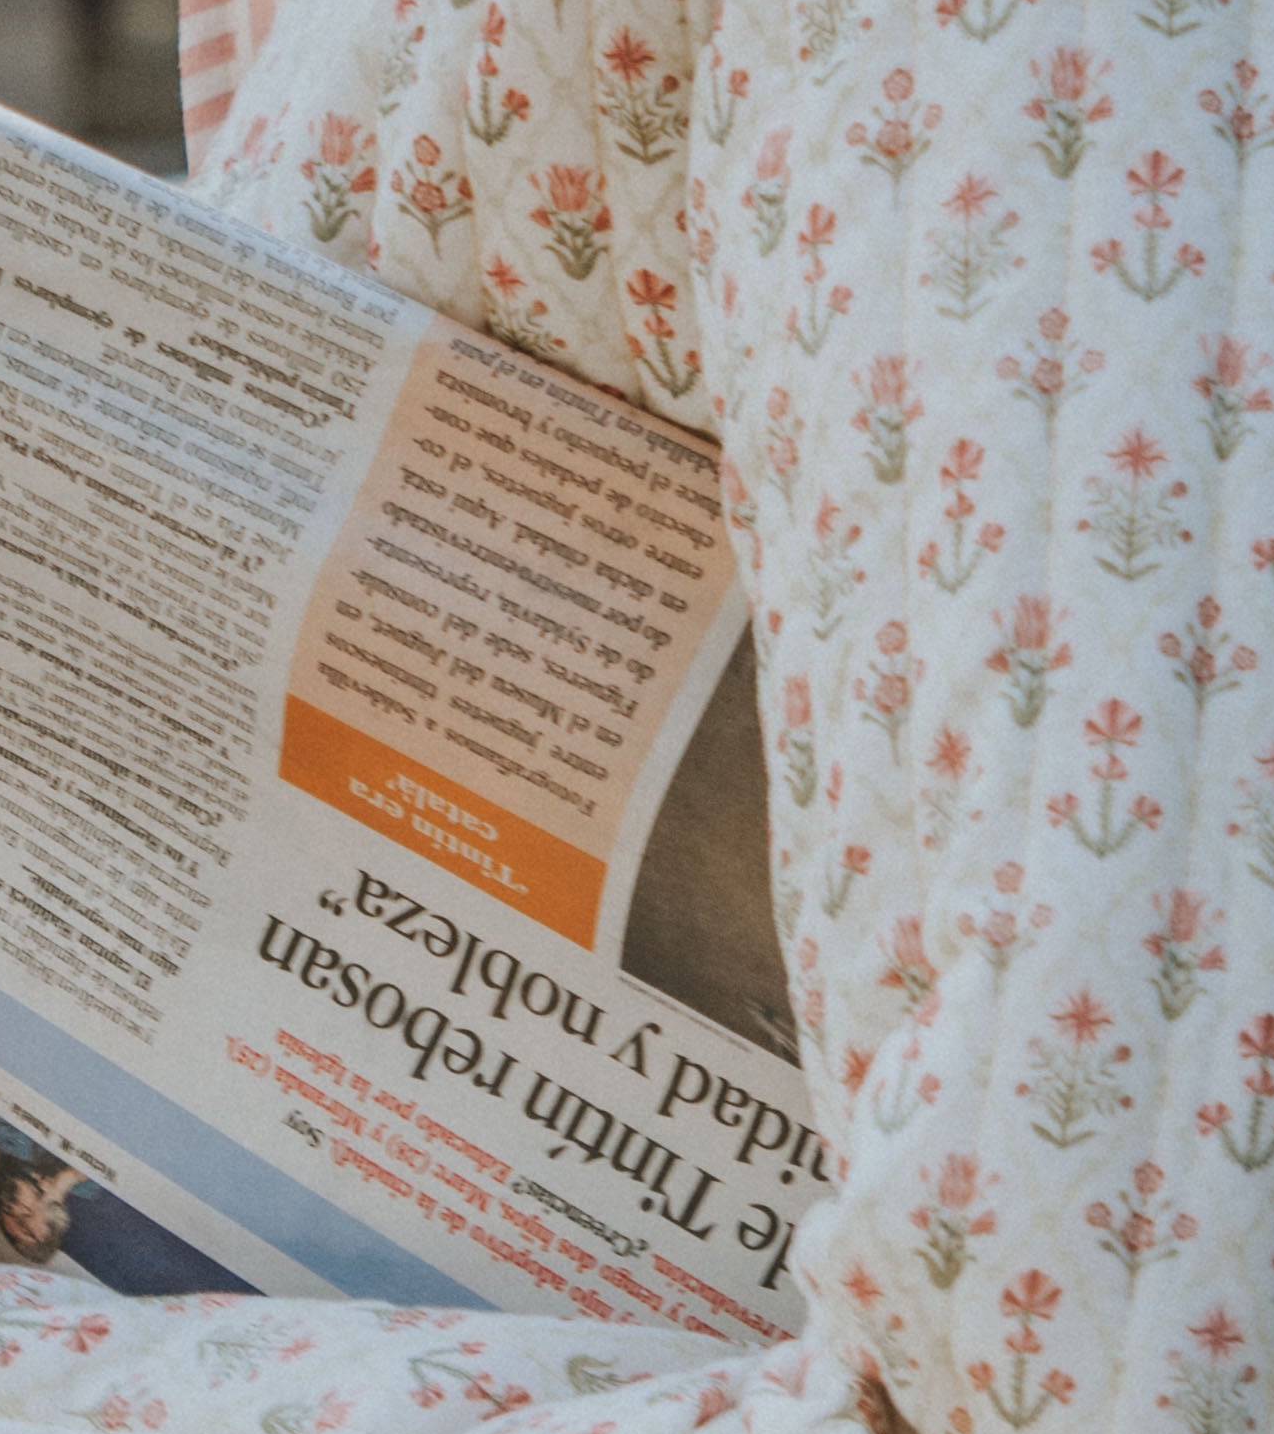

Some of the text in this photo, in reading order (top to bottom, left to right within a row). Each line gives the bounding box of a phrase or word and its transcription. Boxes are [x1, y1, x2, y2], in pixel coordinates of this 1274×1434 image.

[23, 197, 51, 227] las
[78, 250, 103, 271] en
[101, 234, 127, 260] de
[127, 247, 156, 276] los
[107, 265, 211, 322] ejemplares
[220, 264, 256, 292] del
[12, 274, 115, 330] ejemplares
[236, 298, 285, 329] estos
[122, 325, 147, 348] de
[215, 315, 241, 339] de
[517, 368, 546, 390] en
[434, 368, 534, 433] bromista
[473, 426, 517, 454] que
[532, 414, 555, 436] y
[615, 414, 646, 437] en
[447, 450, 474, 473] el
[551, 426, 652, 481] pequeño
[518, 447, 605, 496] pedales
[647, 470, 673, 493] el
[603, 487, 634, 514] de
[580, 513, 640, 550] otros
[633, 501, 717, 551] checito
[380, 499, 673, 651] do por nuestro entrevistado
[643, 543, 705, 581] entre
[593, 559, 655, 602] dicha
[334, 598, 363, 621] en
[658, 590, 688, 613] en
[440, 611, 480, 642] del
[482, 630, 535, 664] sede
[593, 642, 623, 668] de
[447, 655, 486, 686] del
[624, 657, 656, 684] do
[316, 660, 598, 818] Fotografiamos a Soldevilla
[447, 694, 544, 754] juguetes
[565, 711, 592, 734] el
[594, 724, 624, 748] en
[548, 743, 610, 782] entre
[347, 776, 405, 819] era
[317, 868, 607, 1046] nobleza”
[257, 912, 520, 1098] rebosan
[274, 1027, 349, 1087] Iglesia
[607, 1020, 663, 1079] y
[273, 1064, 369, 1137] Miranda
[348, 1072, 373, 1102] la
[370, 1088, 418, 1121] por
[281, 1108, 325, 1149] Soy
[366, 1121, 389, 1144] y
[414, 1113, 513, 1185] Educado
[522, 1070, 723, 1241] Tintín
[431, 1162, 495, 1214] Marc
[415, 1189, 439, 1221] la
[438, 1205, 468, 1235] de
[510, 1174, 651, 1259] ¿Creencias?
[468, 1224, 569, 1293] adoptivo
[556, 1237, 599, 1274] dos
[567, 1284, 615, 1322] hijo
[598, 1263, 664, 1313] tengo
[663, 1301, 687, 1323] y
